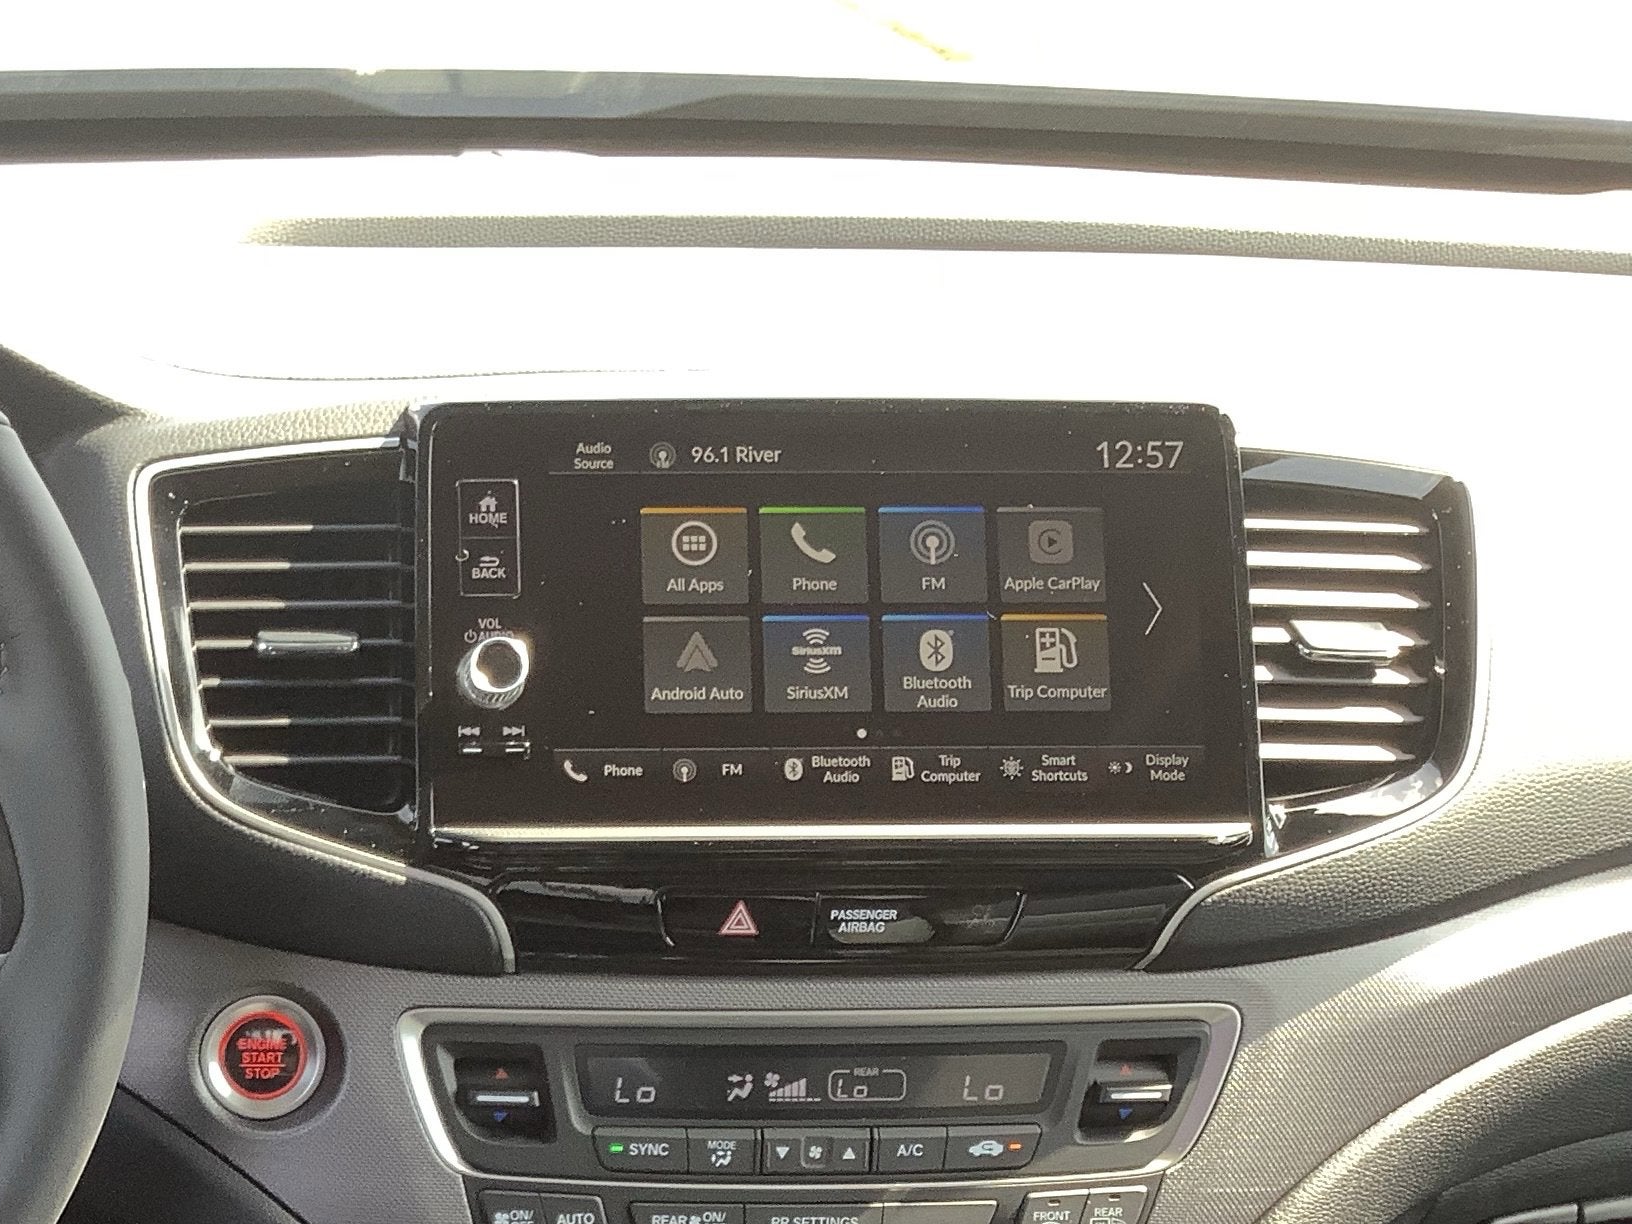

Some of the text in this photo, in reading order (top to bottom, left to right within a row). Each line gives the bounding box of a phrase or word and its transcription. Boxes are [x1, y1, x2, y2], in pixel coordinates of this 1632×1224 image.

[576, 442, 612, 455] Audio
[691, 446, 782, 463] 96.1 River
[1096, 440, 1184, 469] 12:57
[574, 457, 614, 470] Source
[469, 513, 508, 525] HOME
[472, 568, 506, 579] BACK
[666, 577, 724, 594] All Apps
[793, 577, 837, 591] Phone
[922, 577, 946, 591] FM
[1004, 577, 1101, 592] Apple CarPlay
[478, 617, 502, 629] VOL
[903, 676, 972, 690] Bluetooth
[651, 686, 744, 700] Android Auto
[787, 686, 849, 700] SiriusXM
[1008, 685, 1108, 700] Trip Computer
[917, 695, 958, 709] Audio
[811, 755, 871, 768] Bluetooth
[938, 755, 962, 769] Trip
[1041, 754, 1076, 767] Smart
[1145, 754, 1189, 769] Display
[604, 764, 643, 777] Phone
[722, 764, 743, 776] FM
[823, 770, 860, 783] Audio
[1031, 769, 1088, 783] Shortcuts
[1150, 769, 1186, 782] Mode
[921, 770, 981, 785] Computer
[830, 909, 898, 921] PASSENGER
[838, 922, 886, 934] AIRBAG
[236, 1038, 287, 1050] ENGINE
[241, 1052, 284, 1063] START
[245, 1068, 281, 1079] STOP
[853, 1066, 879, 1077] REAR
[629, 1143, 669, 1157] SYNC
[708, 1140, 736, 1150] MODE
[896, 1143, 923, 1157] A/C
[510, 1208, 534, 1221] ON/
[702, 1210, 726, 1223] ON/
[1033, 1210, 1070, 1222] FRONT
[1094, 1207, 1123, 1218] REAR
